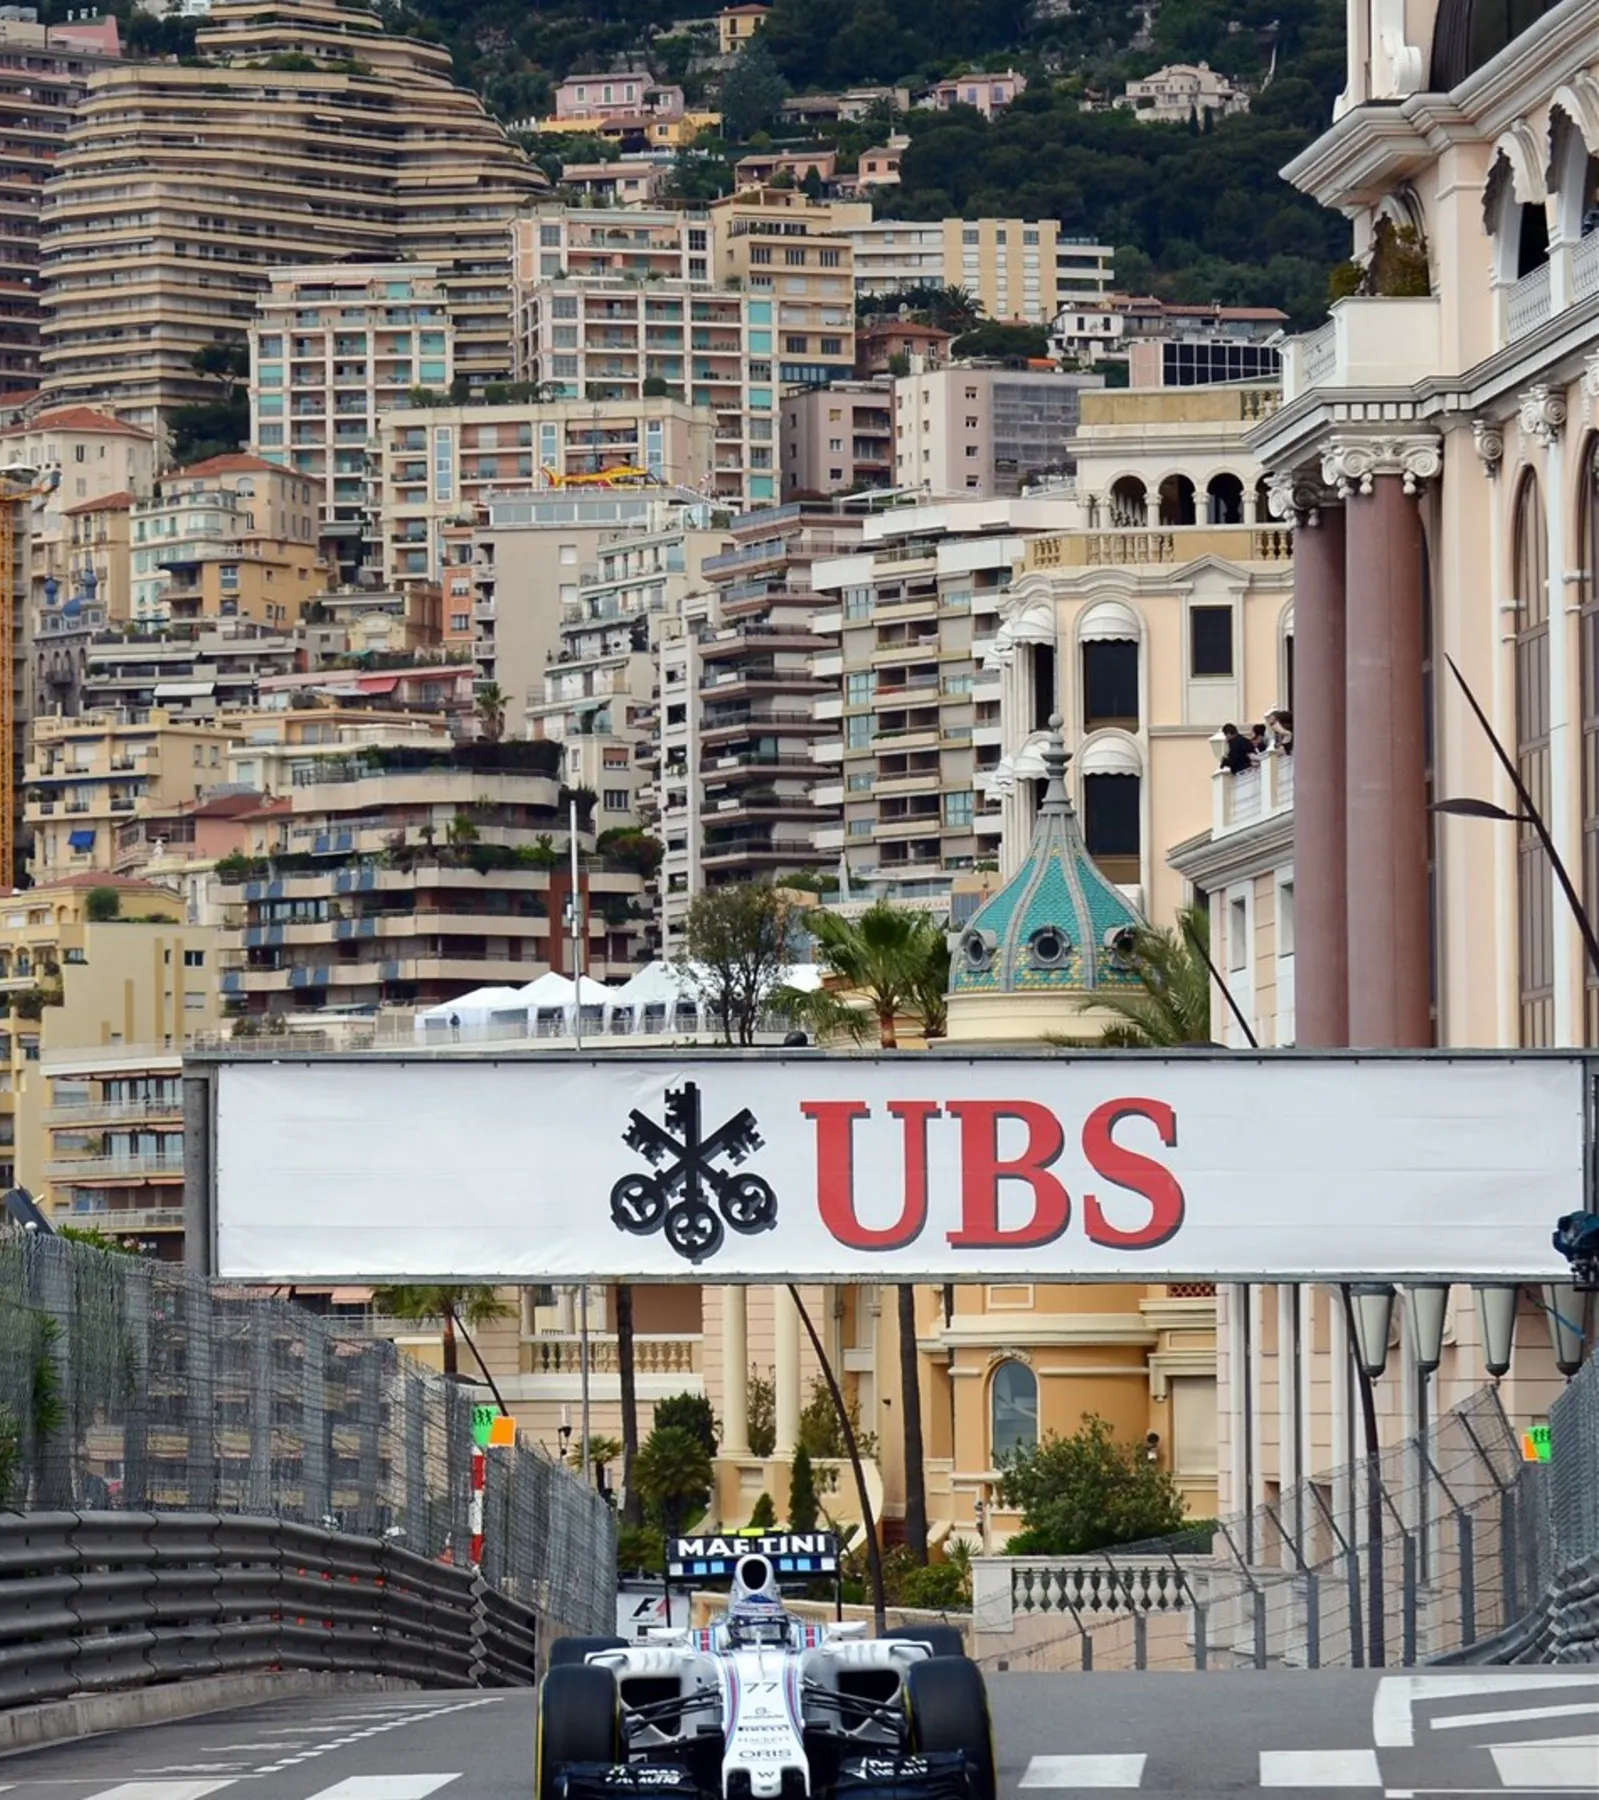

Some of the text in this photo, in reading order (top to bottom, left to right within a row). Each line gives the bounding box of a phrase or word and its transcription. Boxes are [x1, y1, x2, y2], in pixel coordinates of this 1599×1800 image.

[801, 1097, 1183, 1250] UBS
[678, 1535, 825, 1557] MARTINI
[743, 1682, 779, 1694] 77
[739, 1749, 792, 1758] ORIS
